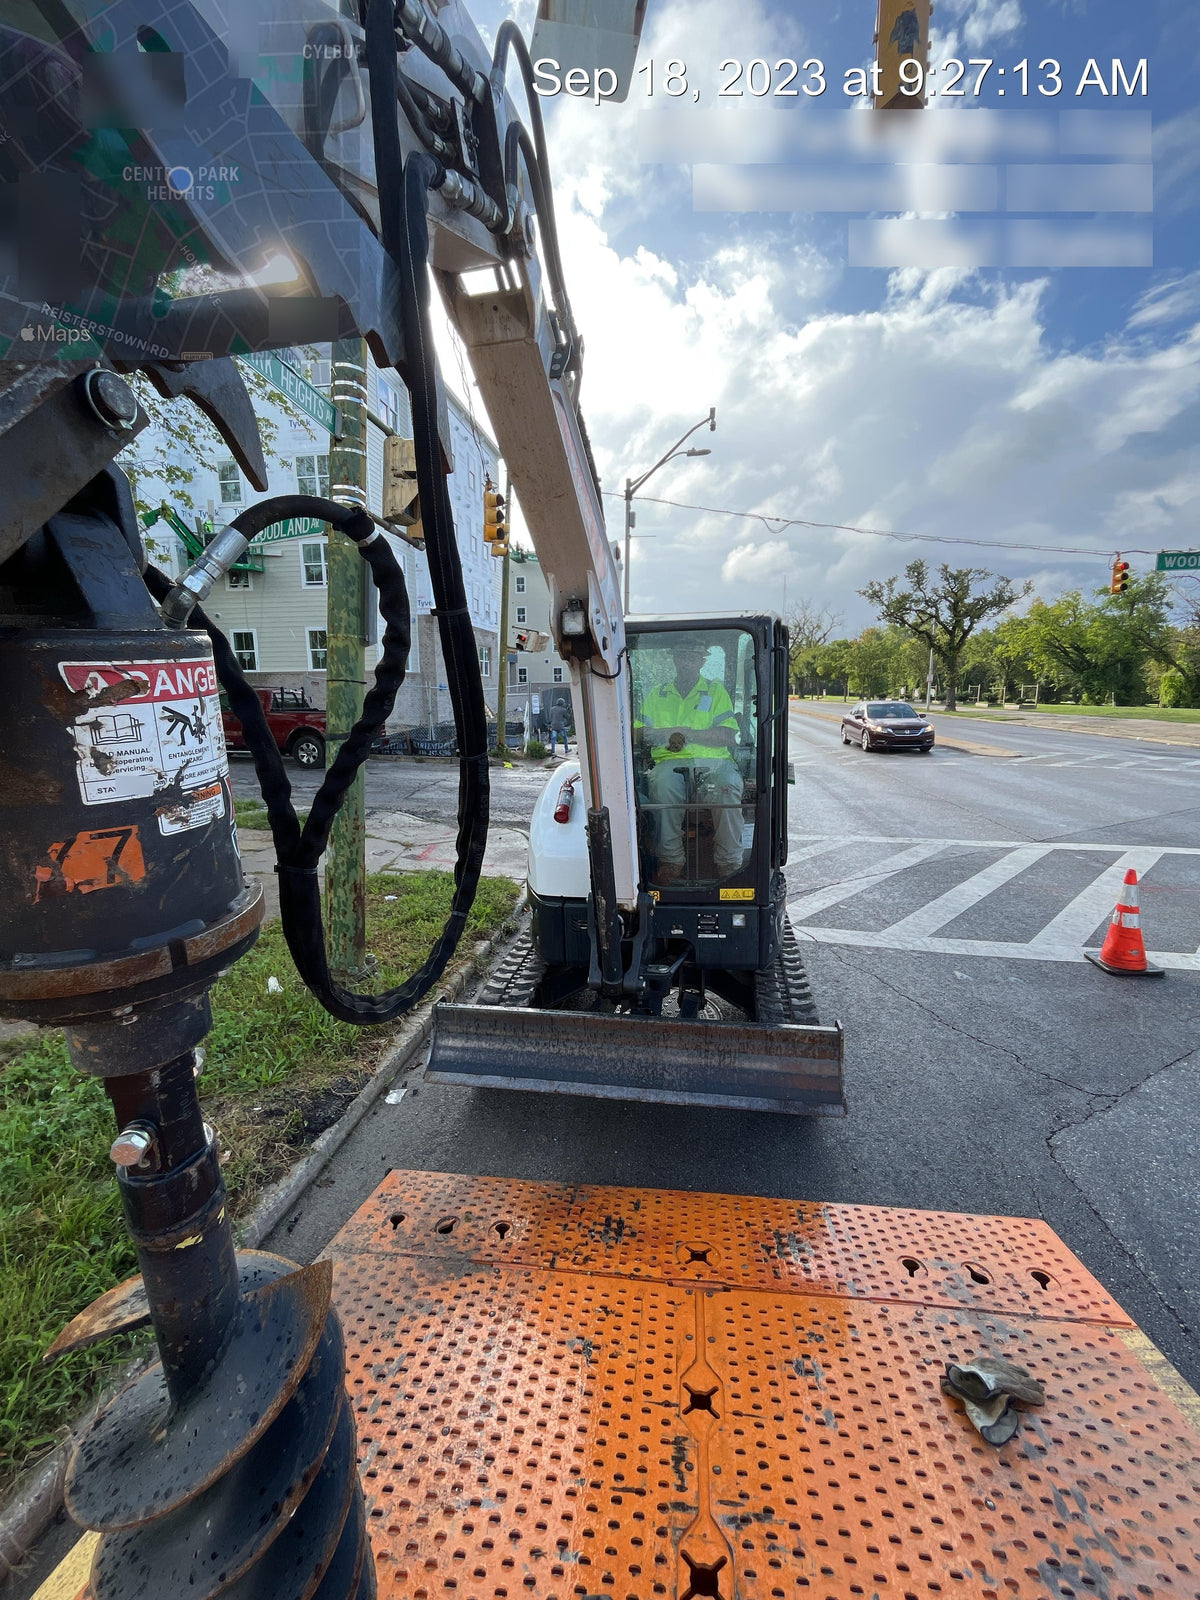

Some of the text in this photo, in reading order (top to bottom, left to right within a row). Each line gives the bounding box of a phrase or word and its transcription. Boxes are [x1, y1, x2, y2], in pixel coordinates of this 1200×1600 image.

[281, 363, 325, 420] HEIGHTS
[1164, 555, 1200, 568] WOO
[126, 667, 217, 699] DANGE
[117, 748, 151, 757] MANUAL
[168, 745, 210, 760] ENTANGLEMENT
[118, 756, 154, 768] operating
